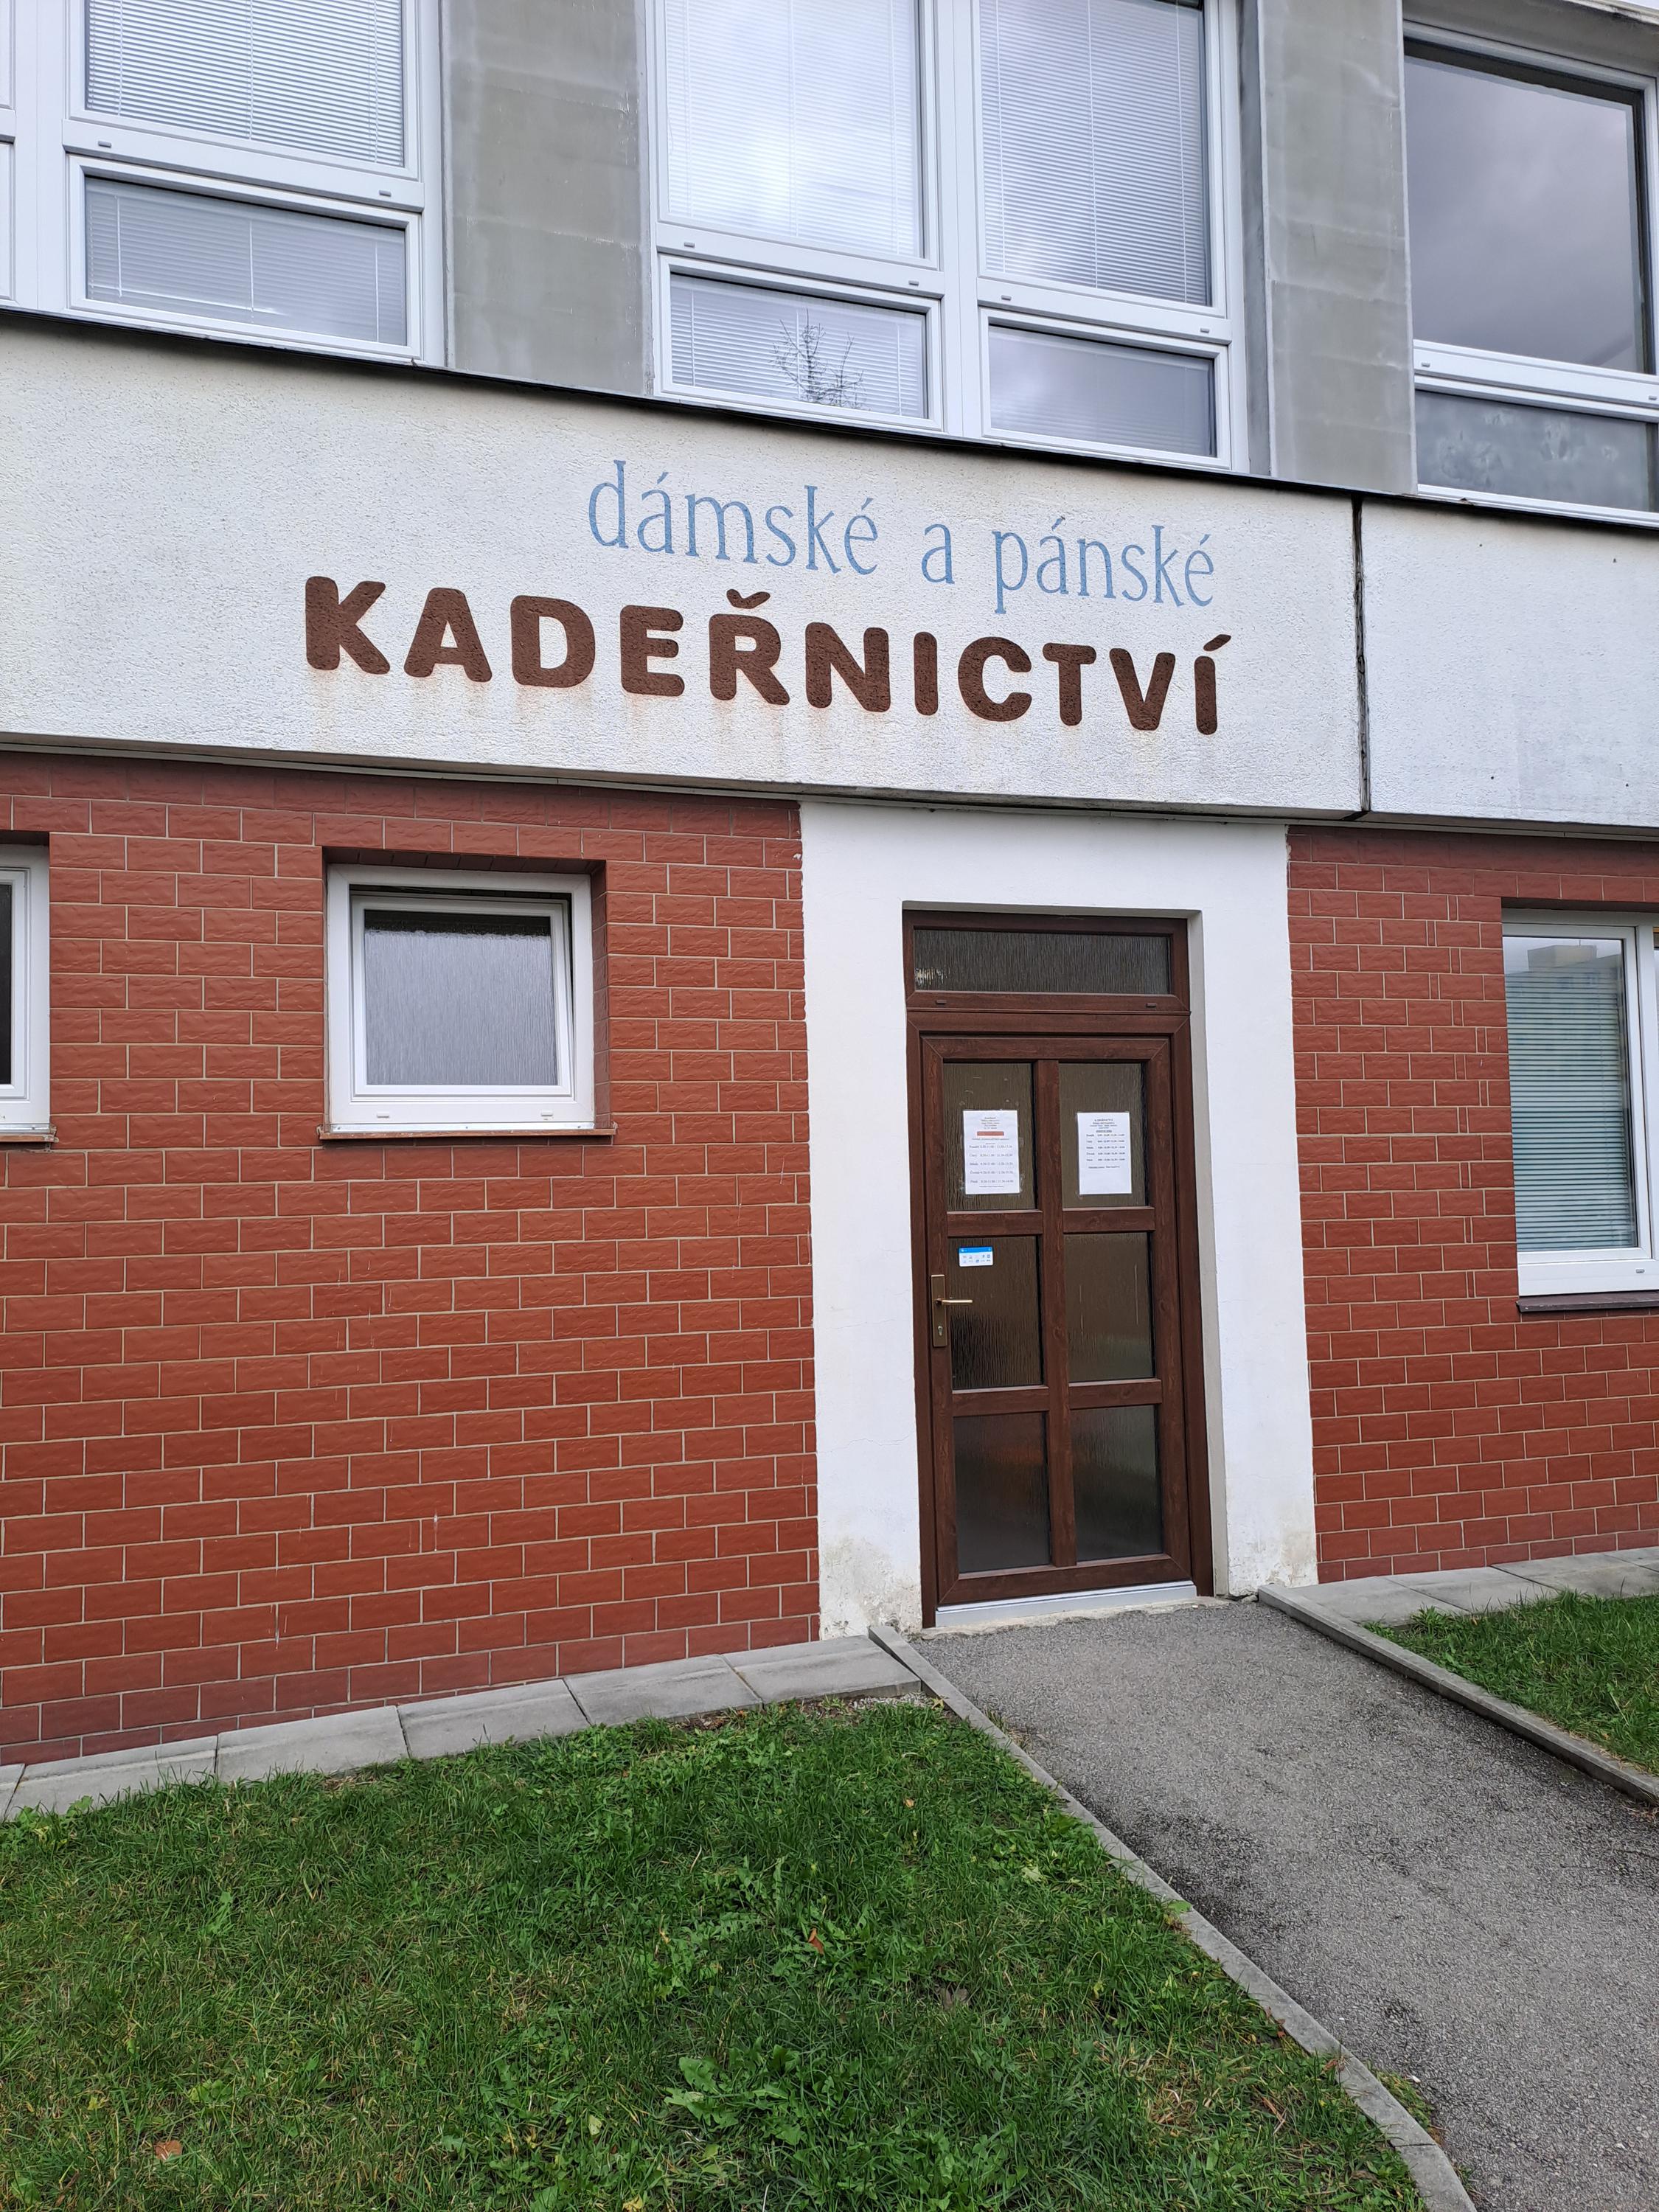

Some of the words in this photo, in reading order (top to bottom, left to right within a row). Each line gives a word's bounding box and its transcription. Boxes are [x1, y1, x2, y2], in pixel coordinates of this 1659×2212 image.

[588, 459, 878, 575] dámské
[922, 524, 954, 585] a
[992, 518, 1214, 614] pánské
[305, 576, 1231, 736] KADEŘNICTVÍ
